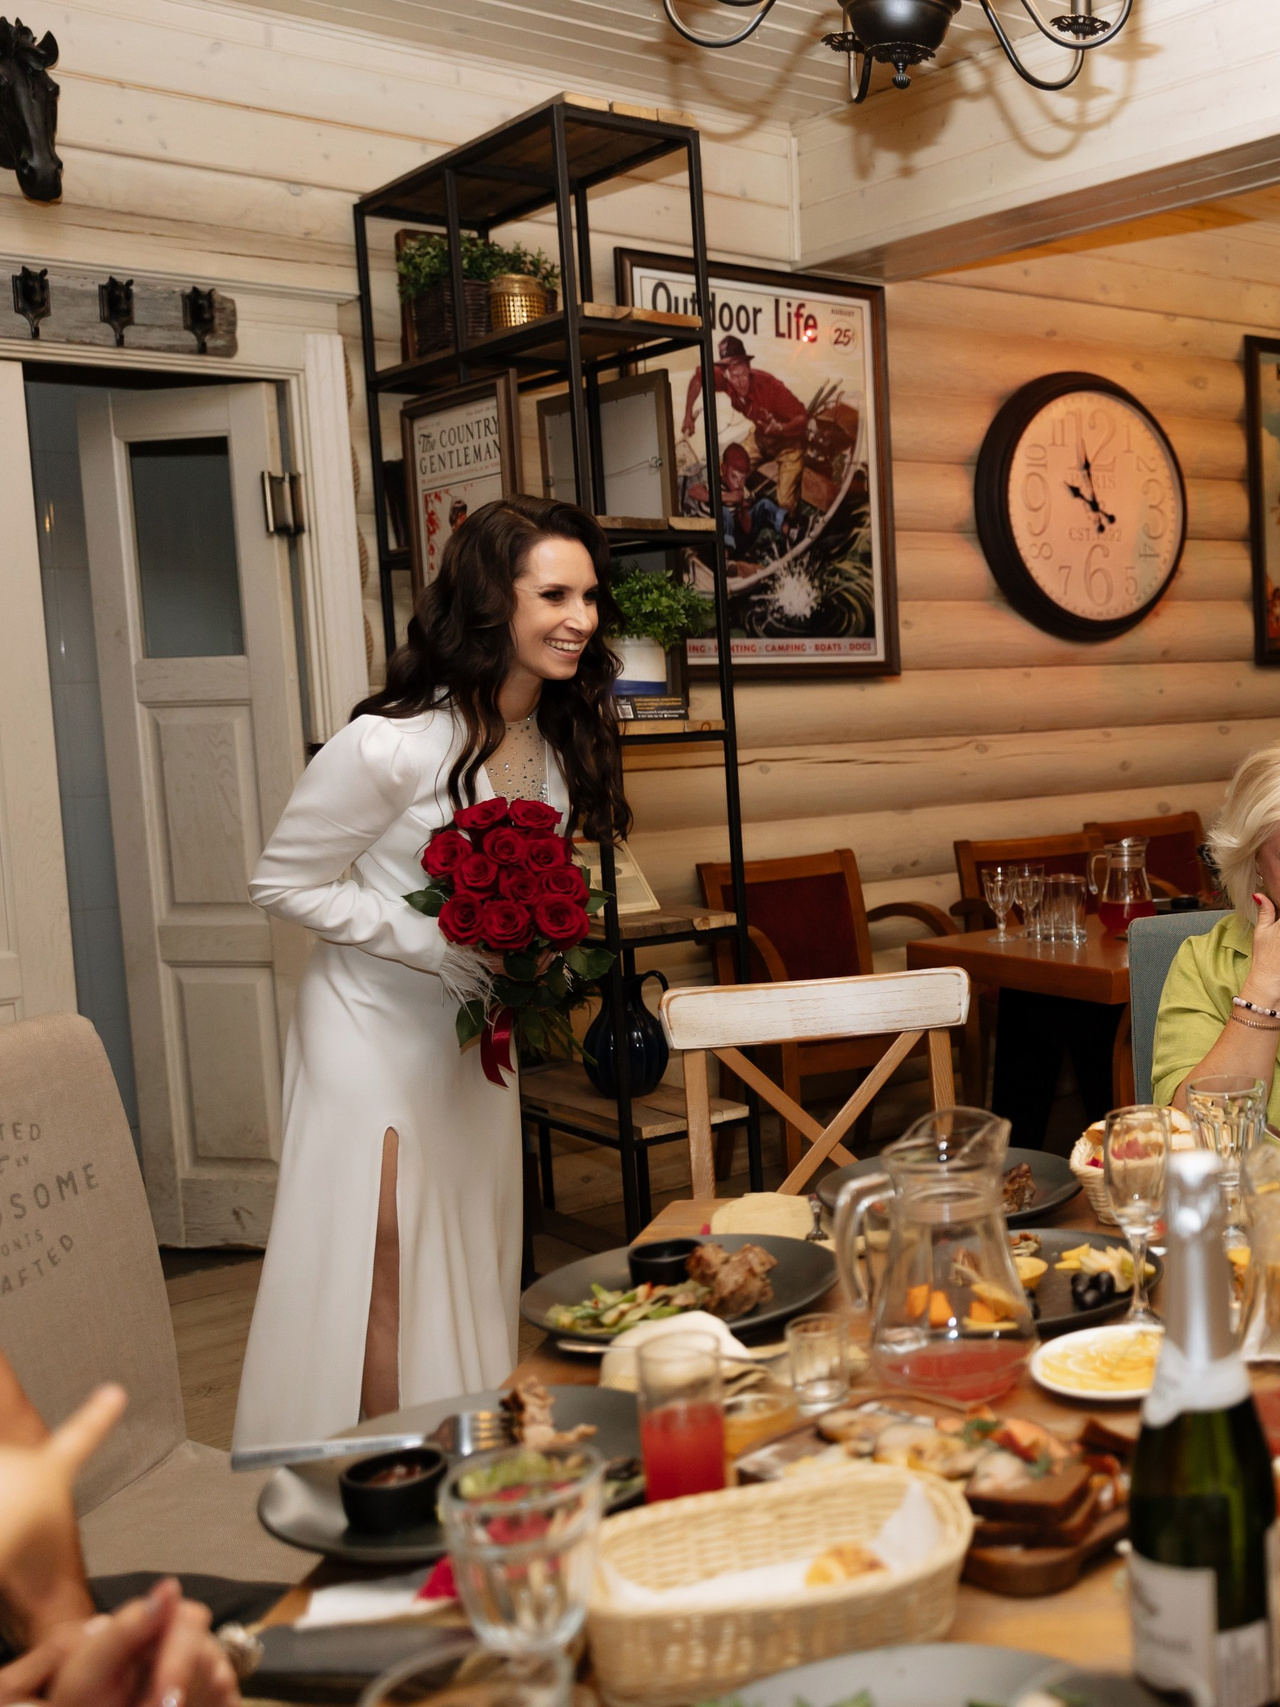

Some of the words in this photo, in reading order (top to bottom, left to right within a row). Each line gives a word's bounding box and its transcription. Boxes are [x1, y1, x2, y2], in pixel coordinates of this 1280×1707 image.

[775, 298, 818, 344] Life
[418, 432, 437, 454] The
[439, 415, 499, 448] COUNTRY
[419, 439, 501, 475] GENTLEMAN
[1058, 565, 1072, 596] 7
[1083, 544, 1114, 607] 6
[765, 643, 807, 652] CAMPING
[814, 642, 842, 651] BOATS
[849, 642, 872, 651] DOGS
[0, 1162, 99, 1226] SOME
